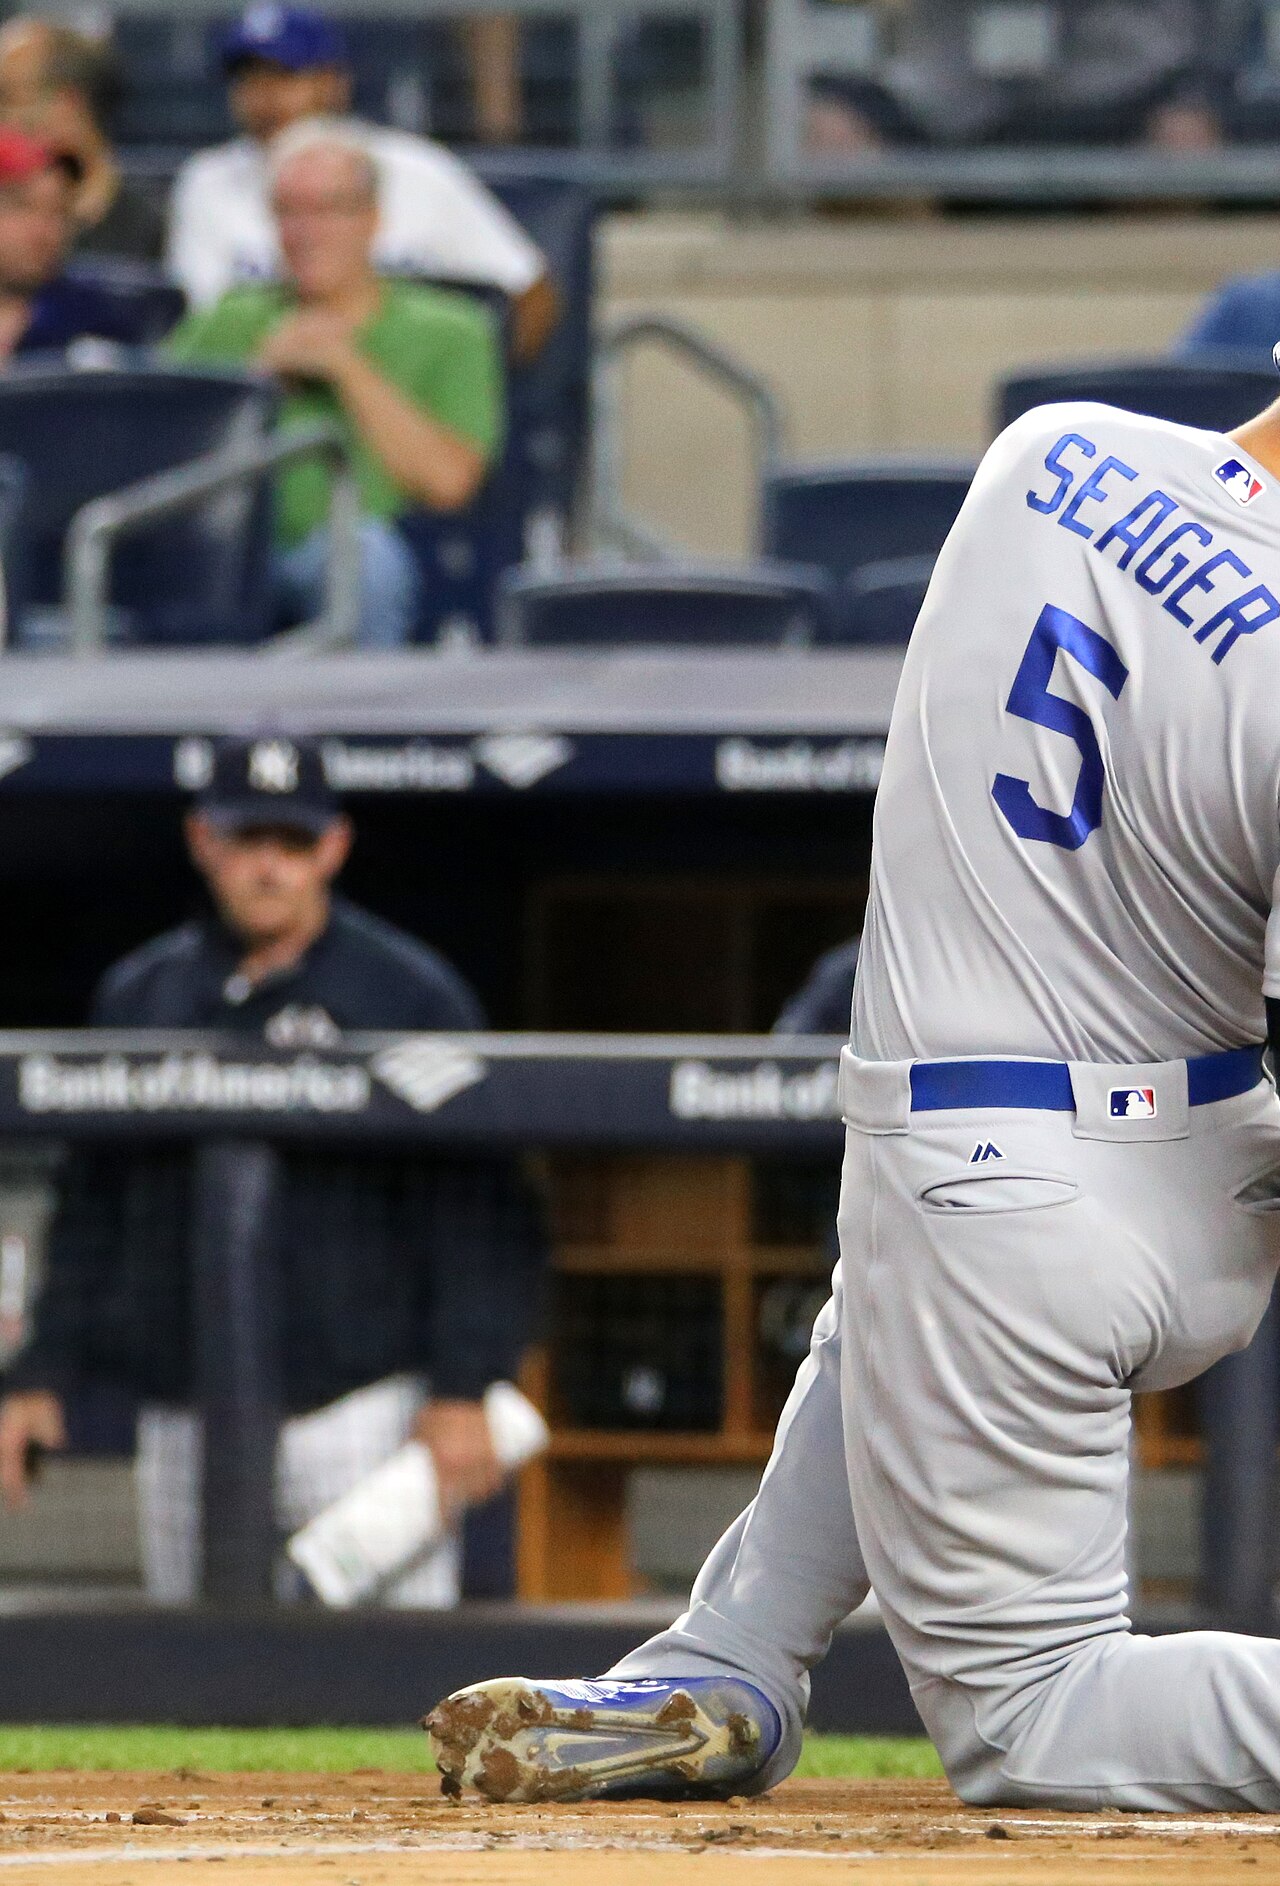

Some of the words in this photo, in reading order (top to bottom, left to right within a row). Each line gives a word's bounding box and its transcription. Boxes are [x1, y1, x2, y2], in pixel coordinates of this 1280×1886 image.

[990, 602, 1130, 851] 5
[19, 1054, 129, 1112] Bank
[185, 1054, 371, 1112] America
[669, 1060, 782, 1120] Bank
